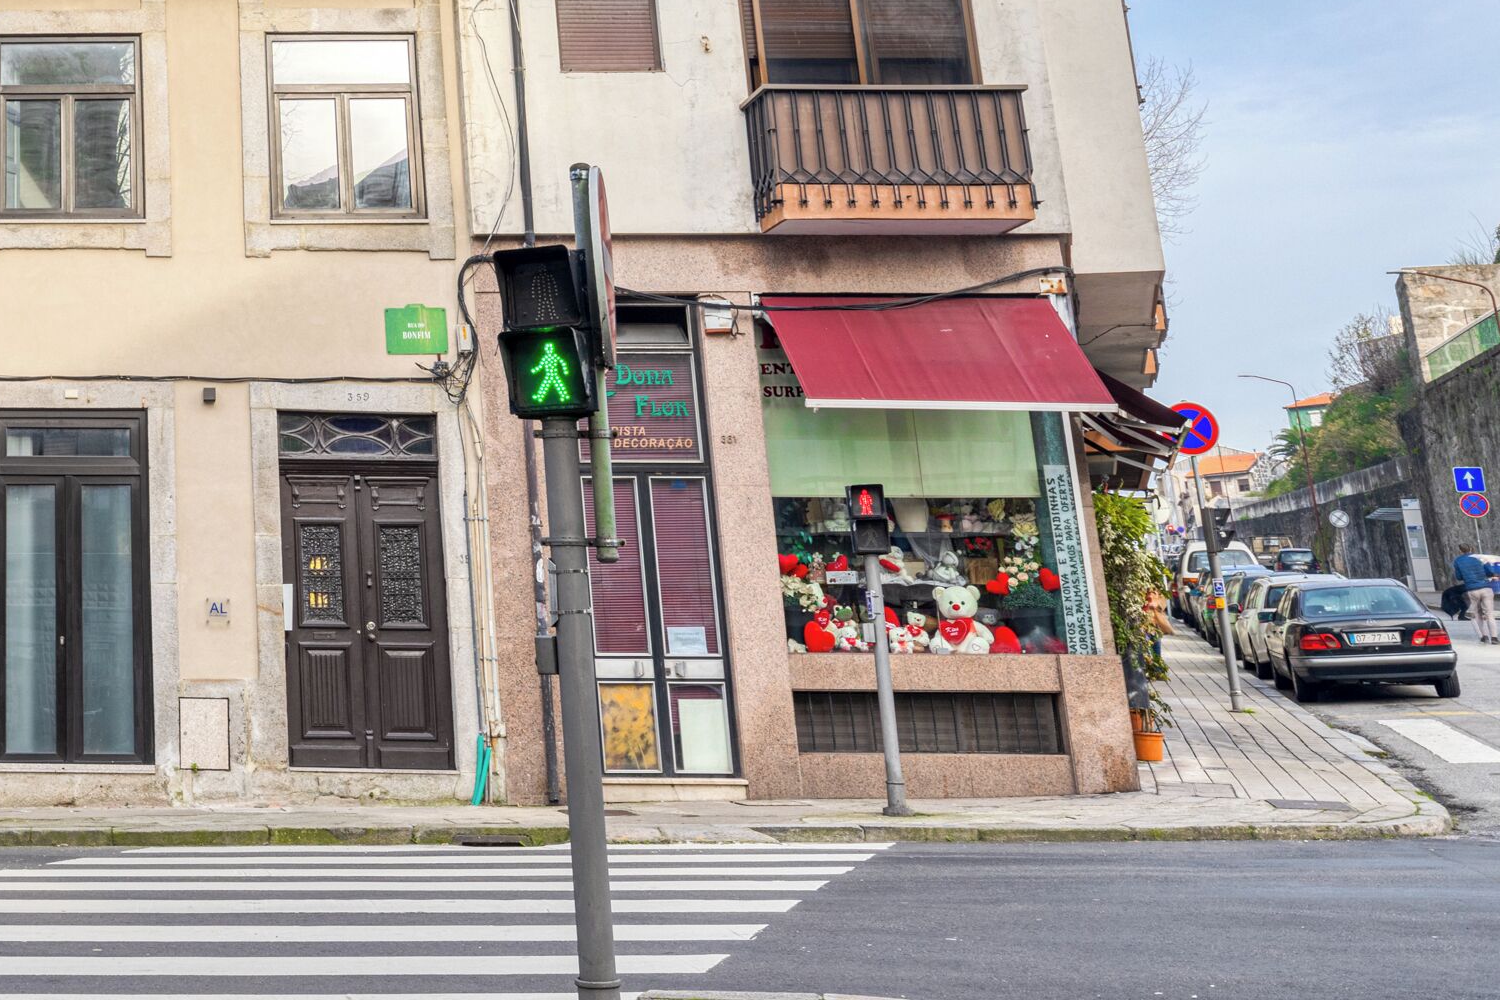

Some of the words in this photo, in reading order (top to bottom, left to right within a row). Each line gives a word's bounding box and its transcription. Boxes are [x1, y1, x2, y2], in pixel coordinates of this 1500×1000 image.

[402, 331, 431, 339] BONFIM
[347, 392, 370, 402] 359
[614, 436, 693, 450] DECORAÇÃO
[1057, 474, 1069, 512] OFERTA
[1047, 478, 1065, 553] PRENDINHAS
[1063, 518, 1073, 541] PARA
[1061, 573, 1072, 602] NOIVA
[210, 602, 227, 614] AL
[1065, 606, 1074, 617] DE
[1067, 622, 1078, 654] RAMOS
